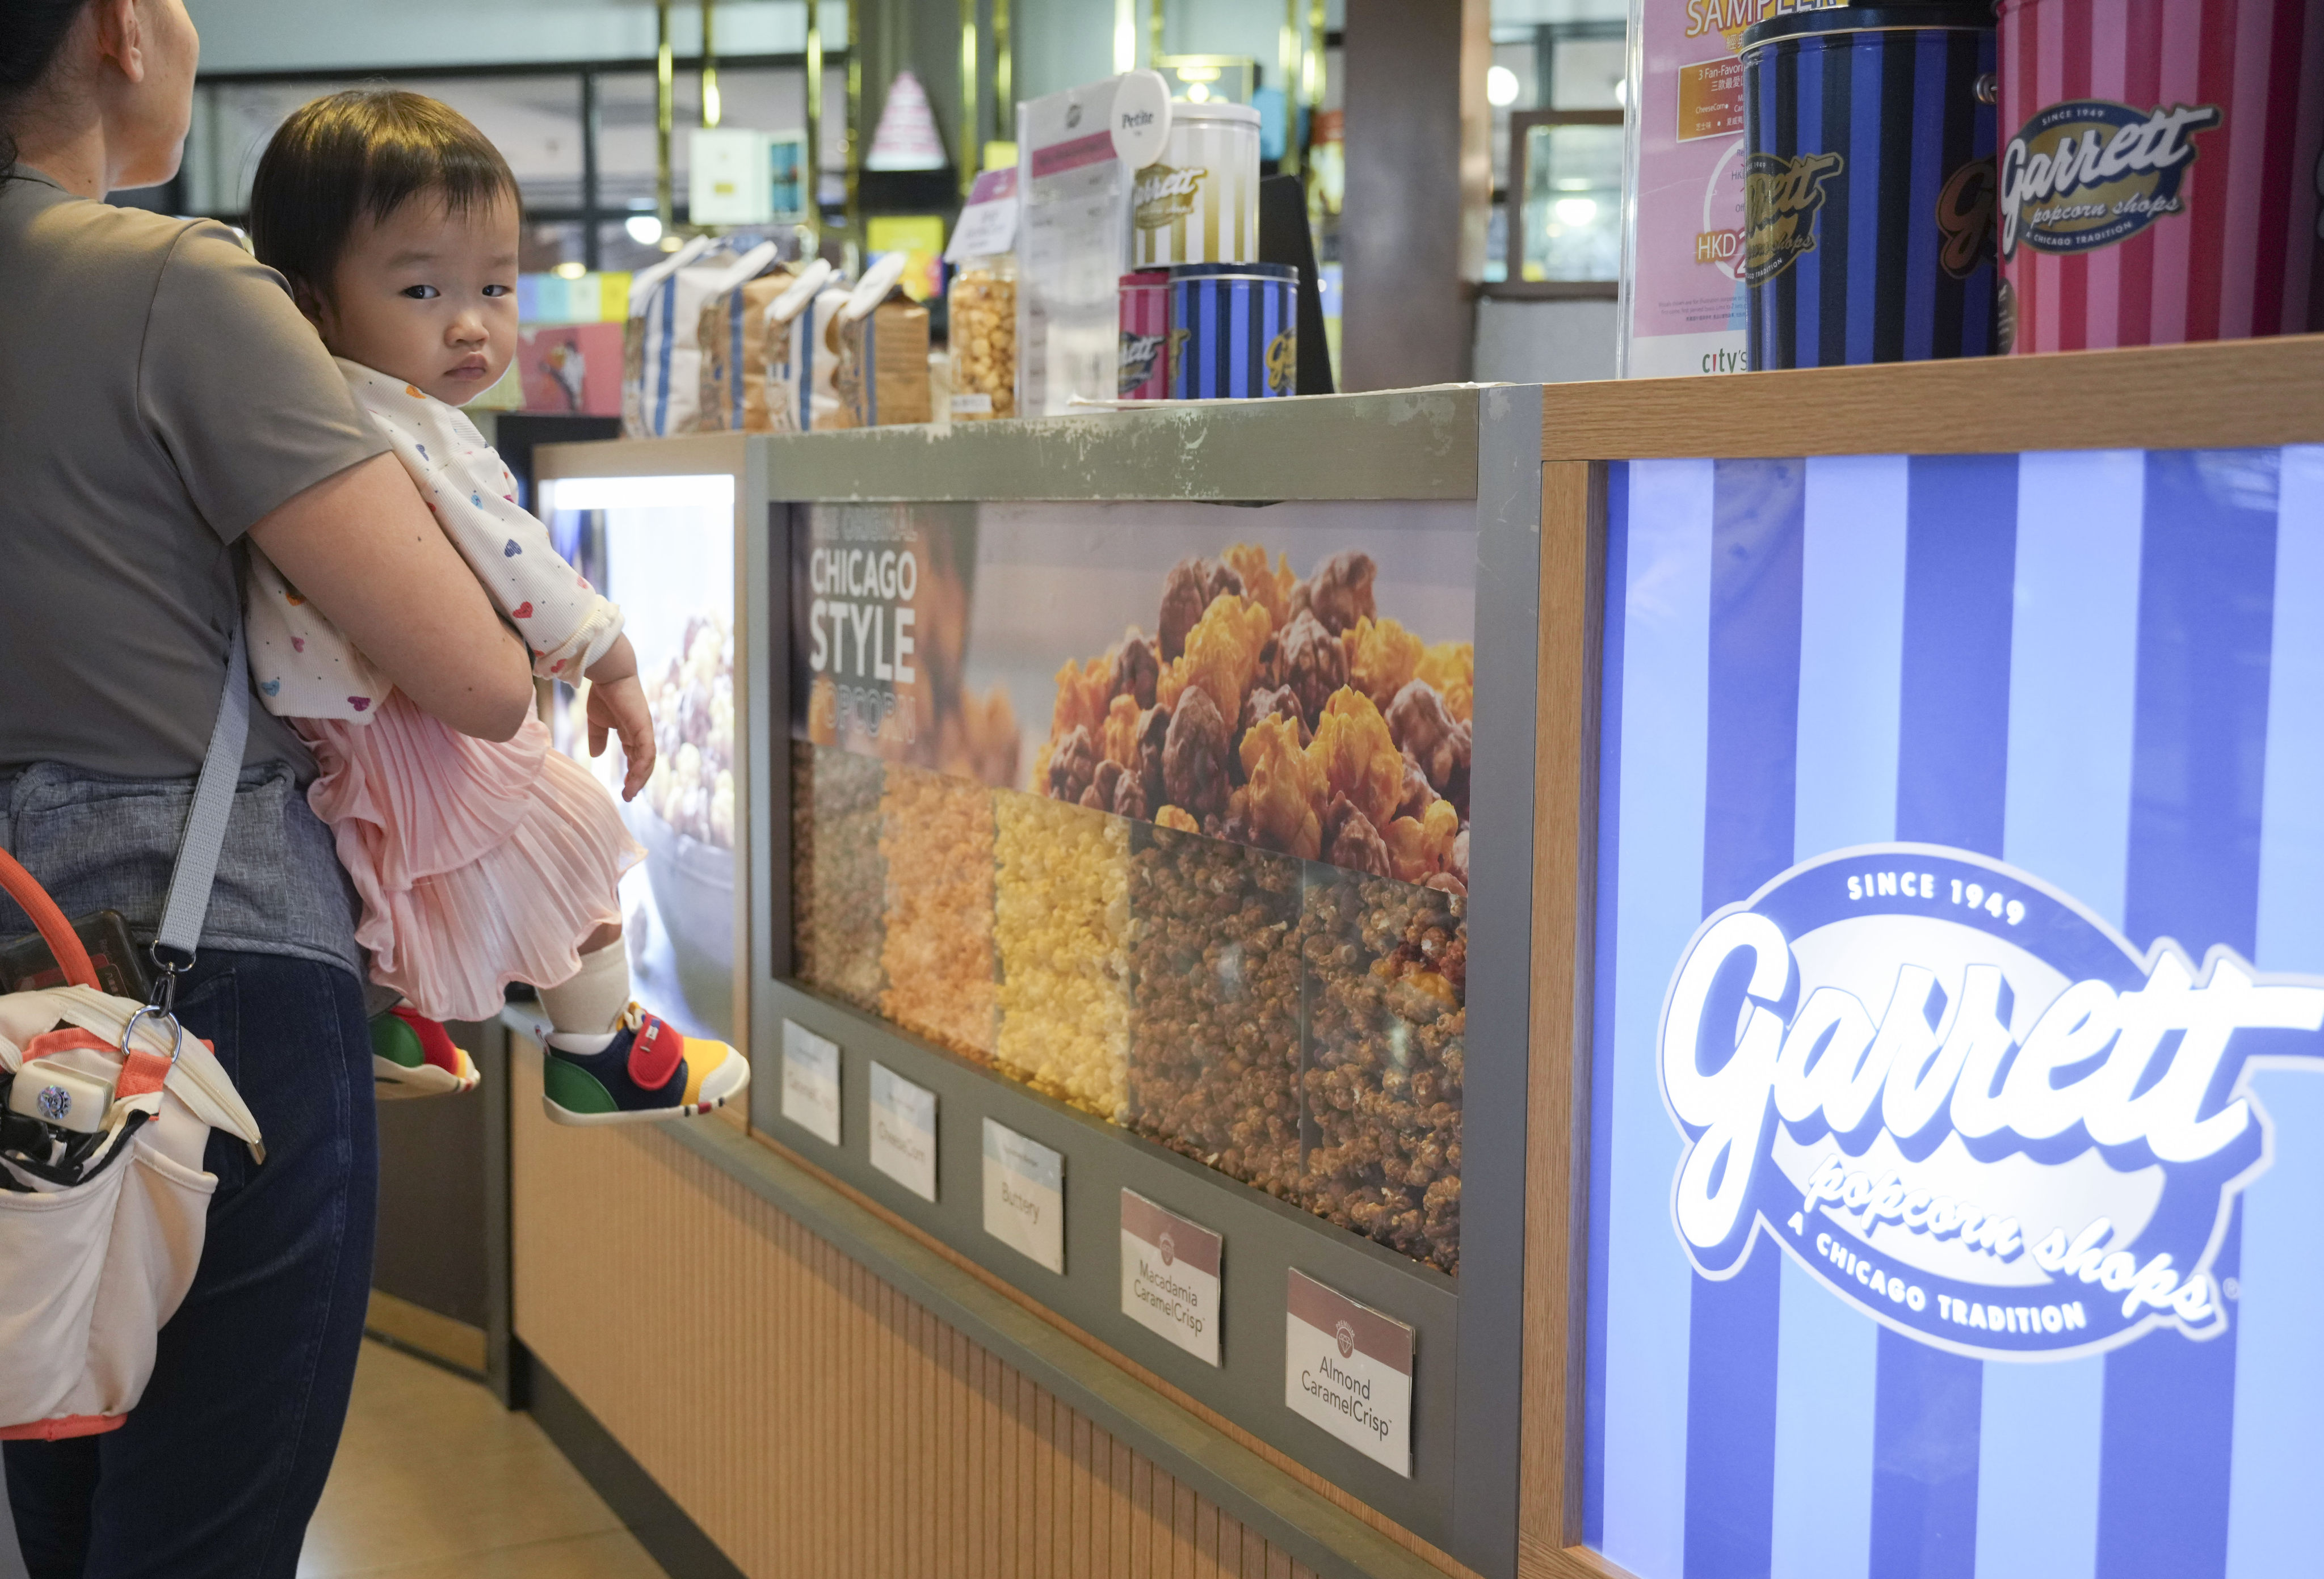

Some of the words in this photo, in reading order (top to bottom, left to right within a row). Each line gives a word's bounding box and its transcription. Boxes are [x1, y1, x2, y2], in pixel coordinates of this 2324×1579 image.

[1698, 70, 1703, 81] 3
[1705, 64, 1744, 79] Fan-Favori
[1696, 103, 1725, 114] CheeseCorn
[1726, 116, 1744, 126] 夏威夷
[2041, 110, 2070, 126] SINCE
[2077, 108, 2104, 117] 1949
[2001, 107, 2213, 255] Garrett
[2030, 201, 2107, 229] popcorn
[2112, 192, 2180, 218] shops
[1698, 233, 1737, 260] HKD
[2025, 230, 2031, 239] A
[2033, 233, 2071, 246] CHICAGO
[2075, 222, 2132, 245] TRADITION
[1756, 258, 1783, 278] TRADITION
[810, 547, 917, 601] CHICAGO
[809, 598, 915, 684] STYLE
[1847, 871, 1935, 901] SINCE
[1950, 879, 2025, 926] 1949
[1663, 912, 2324, 1248] Garrett
[1001, 1181, 1040, 1225] Buttery
[1803, 1153, 2022, 1257] popcorn
[2032, 1216, 2214, 1321] shops
[1139, 1258, 1197, 1307] Macadamia
[1787, 1211, 1804, 1236] A
[1816, 1232, 1926, 1312] CHICAGO
[1936, 1293, 2088, 1334] TRADITION
[1335, 1320, 1355, 1338] PREMIUM
[1319, 1355, 1370, 1401] Almond
